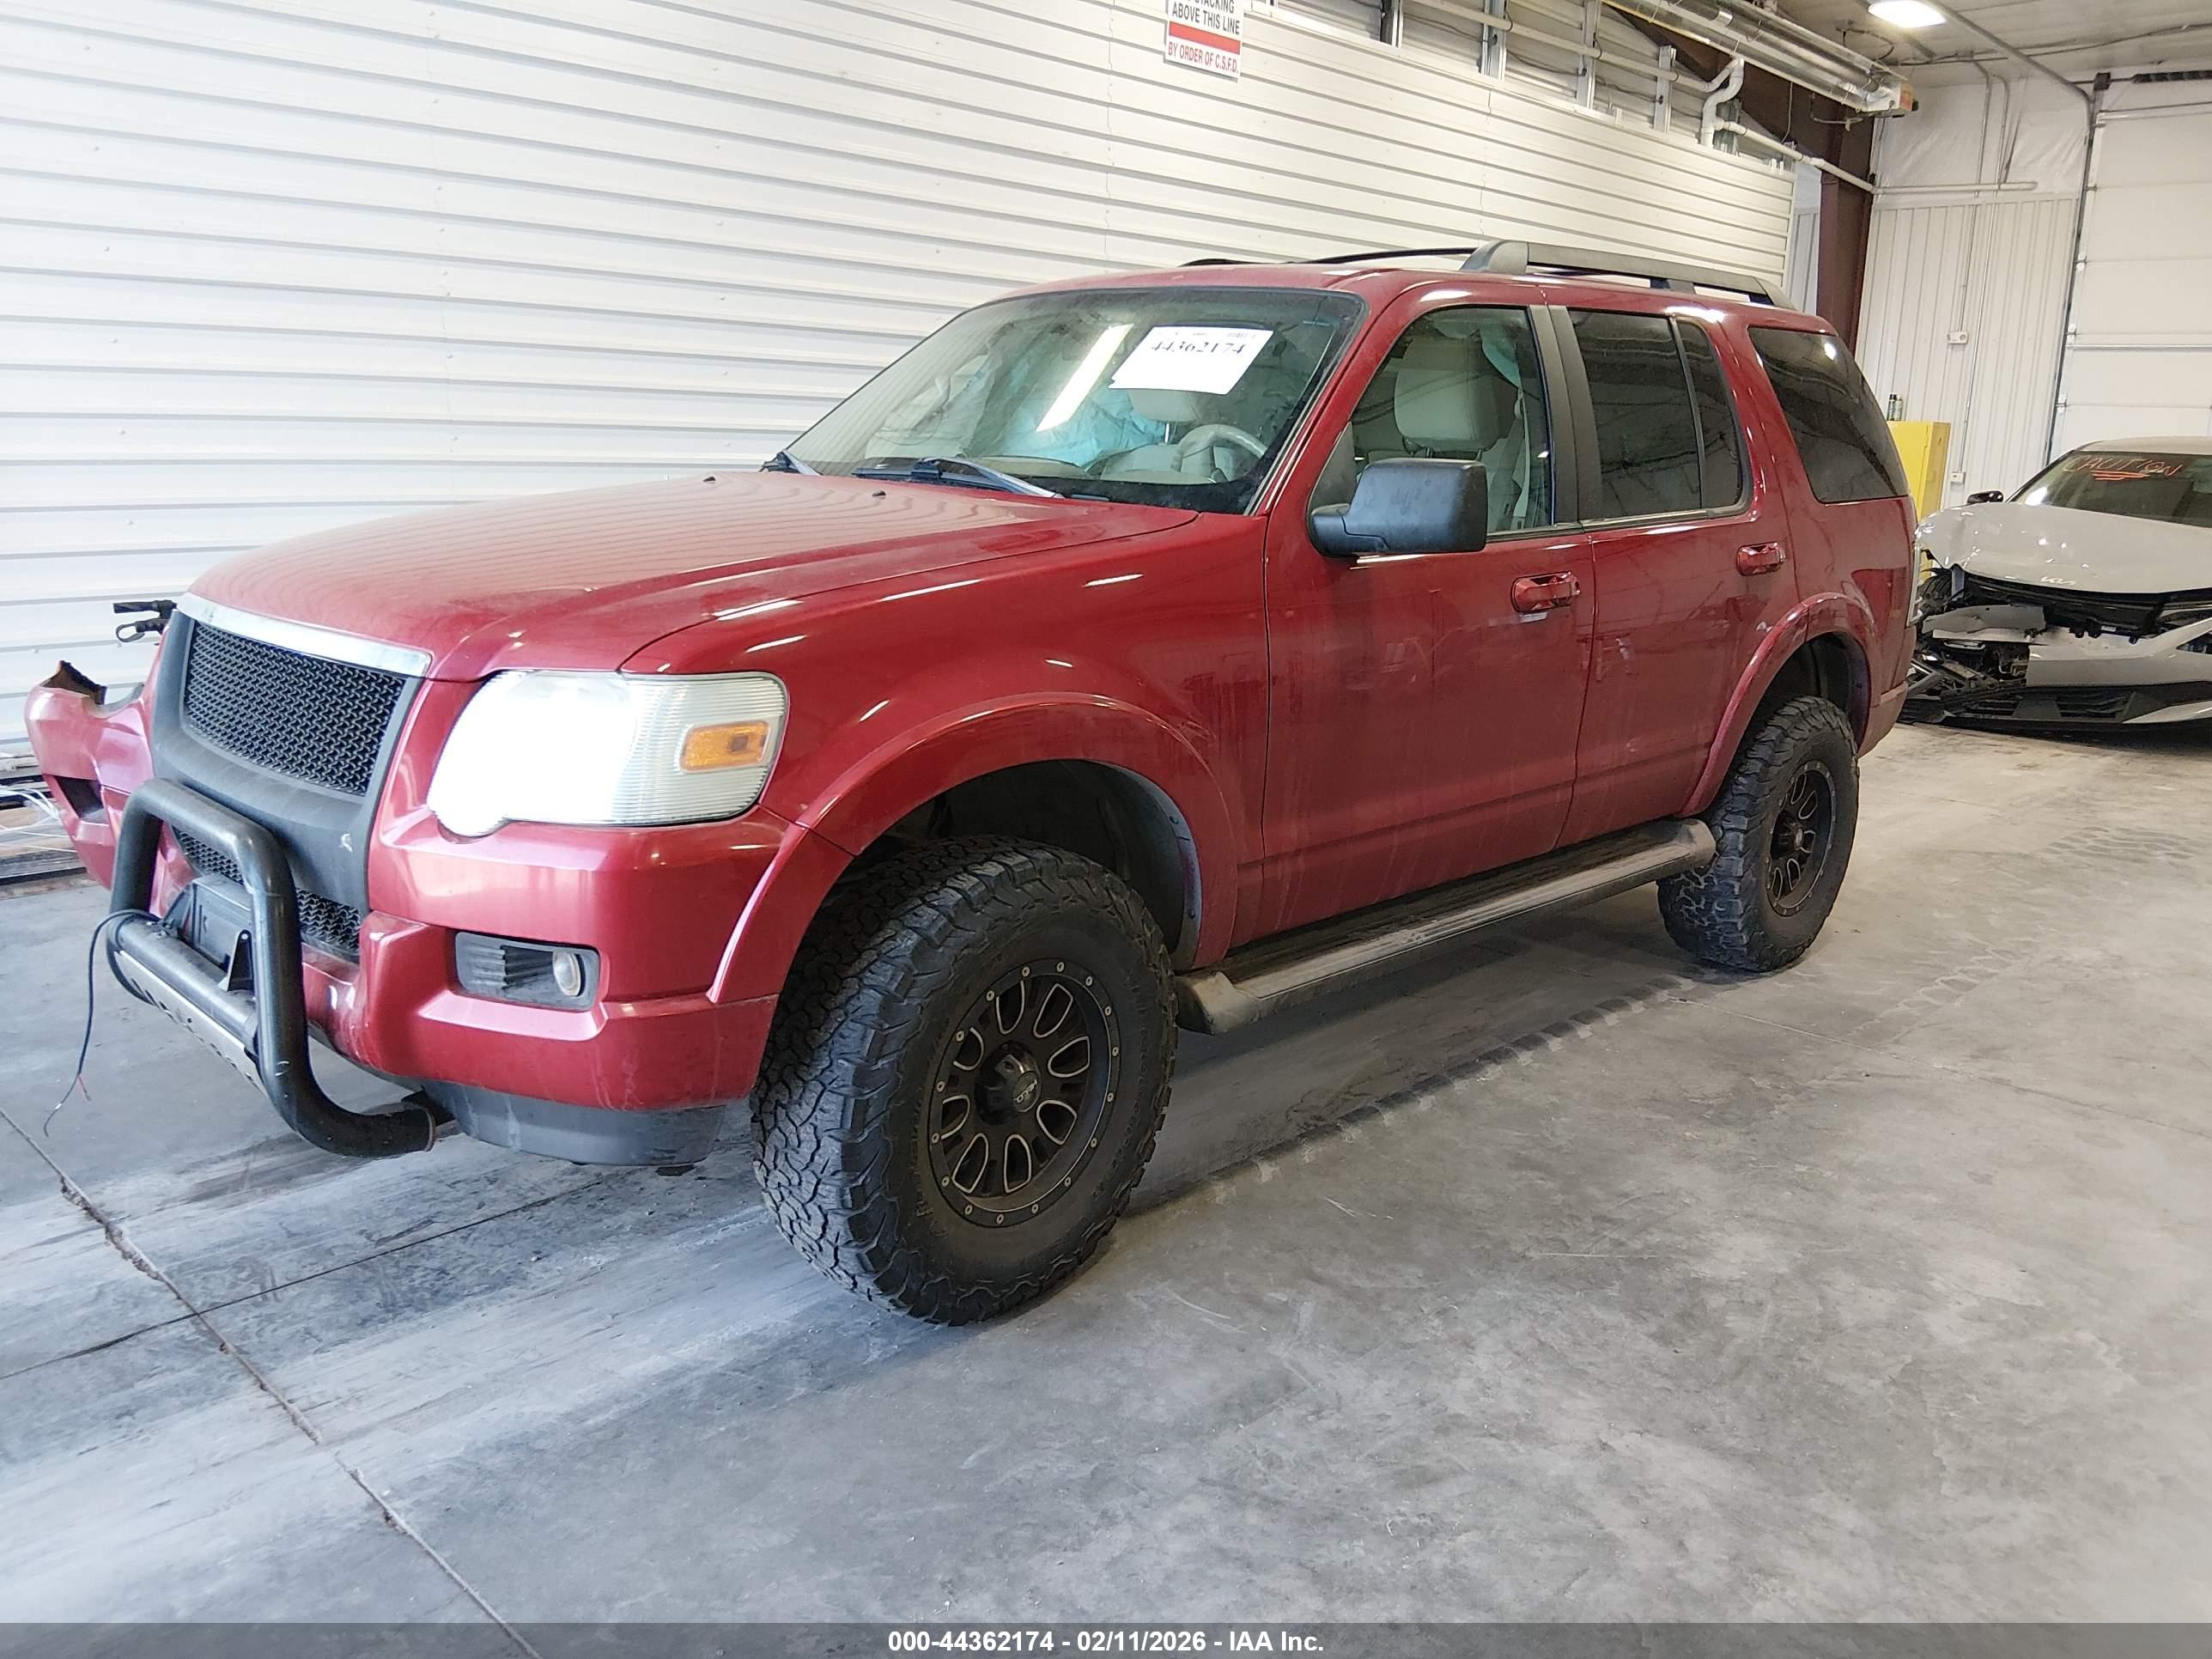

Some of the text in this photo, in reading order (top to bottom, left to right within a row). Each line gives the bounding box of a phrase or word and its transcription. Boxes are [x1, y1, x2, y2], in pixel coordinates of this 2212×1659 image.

[1172, 2, 1240, 35] ABOVE THIS LINE
[1195, 0, 1234, 14] ACKING
[1168, 41, 1238, 74] BY ORDER OF C.S.F.D.
[2063, 454, 2183, 477] CAUTION
